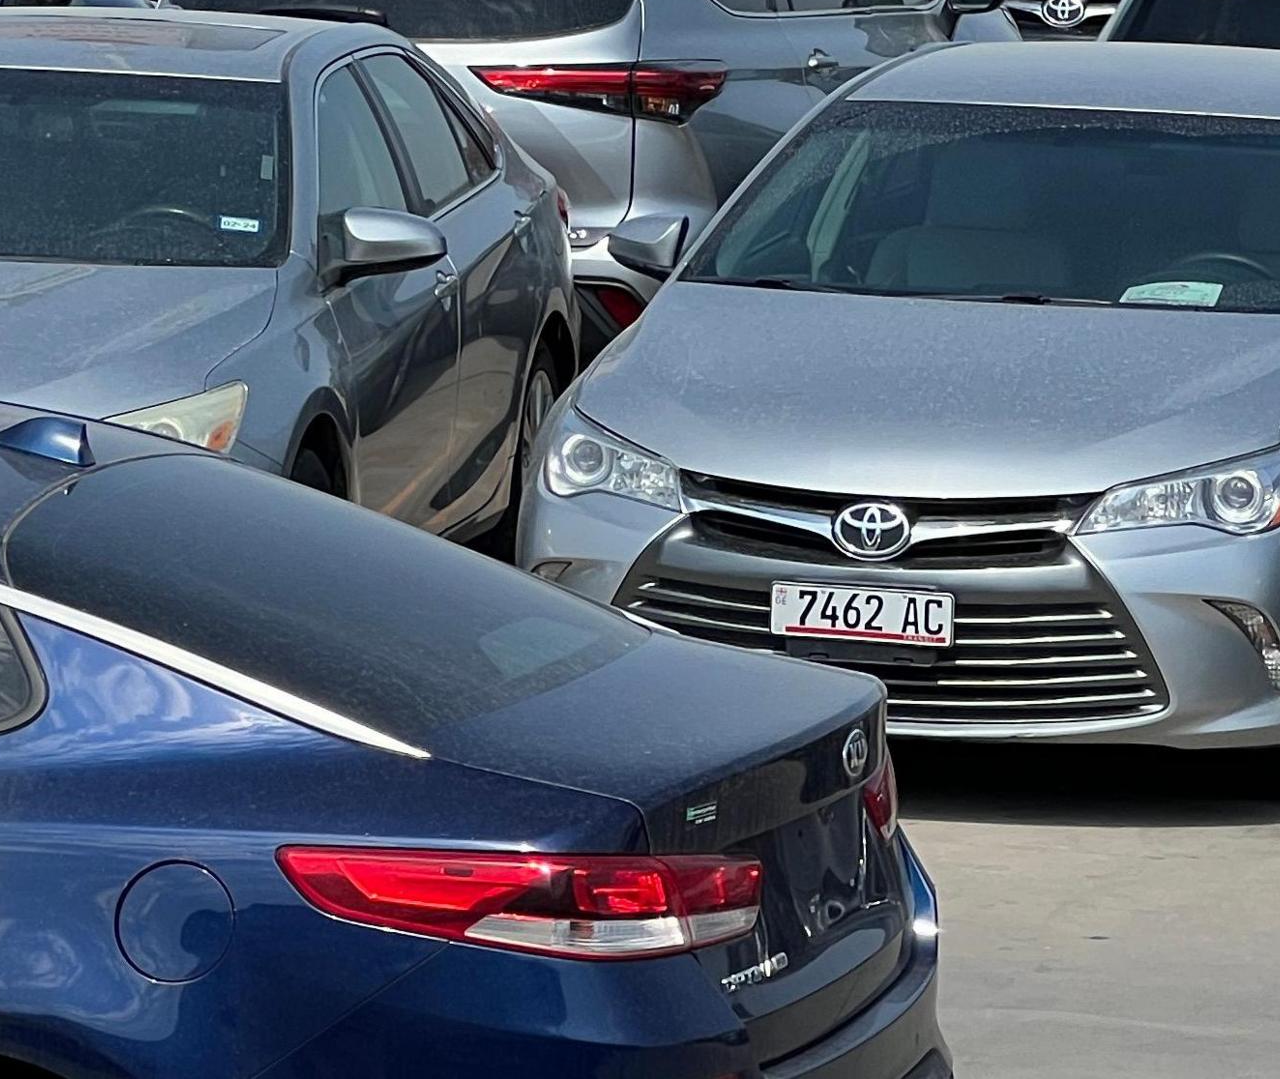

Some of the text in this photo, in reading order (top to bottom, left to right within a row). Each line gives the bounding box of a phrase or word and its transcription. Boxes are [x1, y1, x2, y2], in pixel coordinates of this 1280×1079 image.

[223, 219, 256, 229] 02-24
[798, 589, 943, 635] 7462 AC
